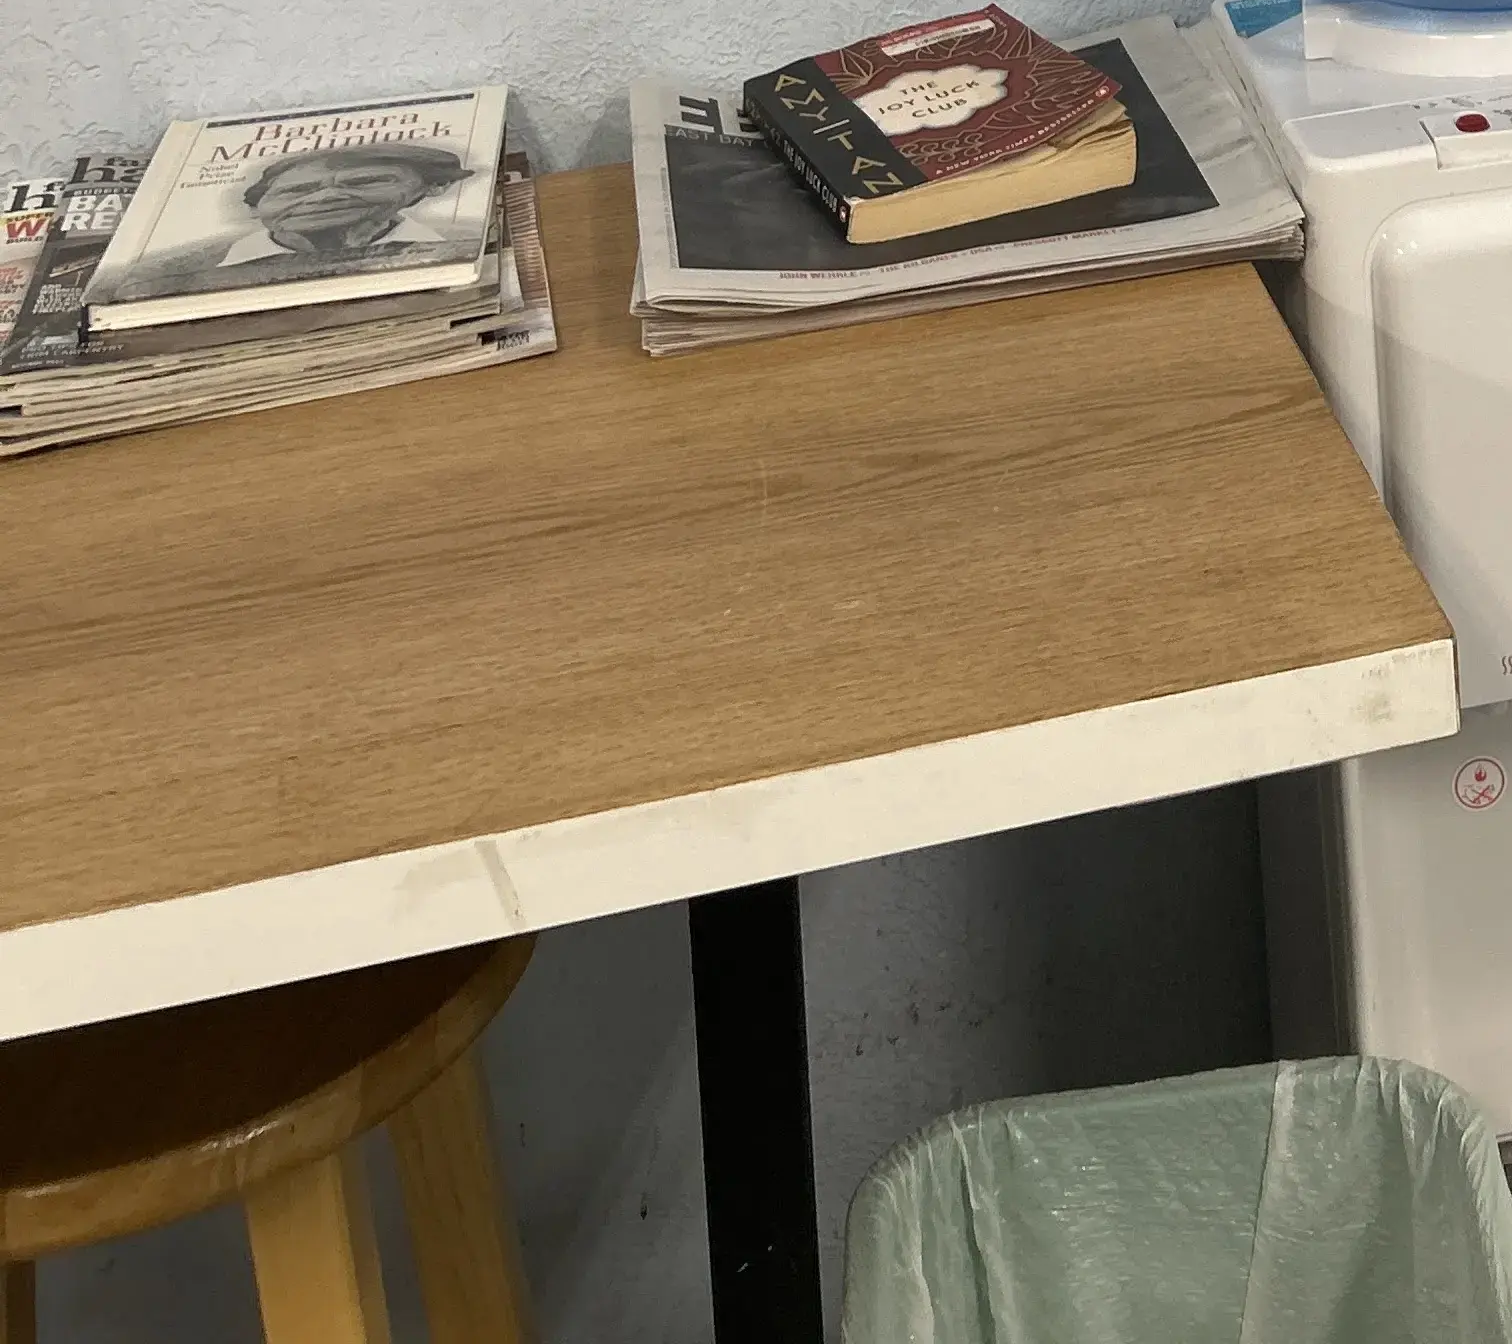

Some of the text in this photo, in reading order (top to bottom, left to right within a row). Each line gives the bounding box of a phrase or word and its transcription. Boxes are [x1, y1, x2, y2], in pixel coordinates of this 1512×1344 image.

[774, 73, 829, 122] AMY
[878, 79, 980, 115] JOY LUCK
[900, 80, 939, 96] THE
[912, 97, 968, 119] CLUB
[211, 121, 453, 163] McClintock
[252, 112, 419, 141] Barbara
[665, 127, 754, 148] EAST BAY
[827, 130, 904, 194] TAN
